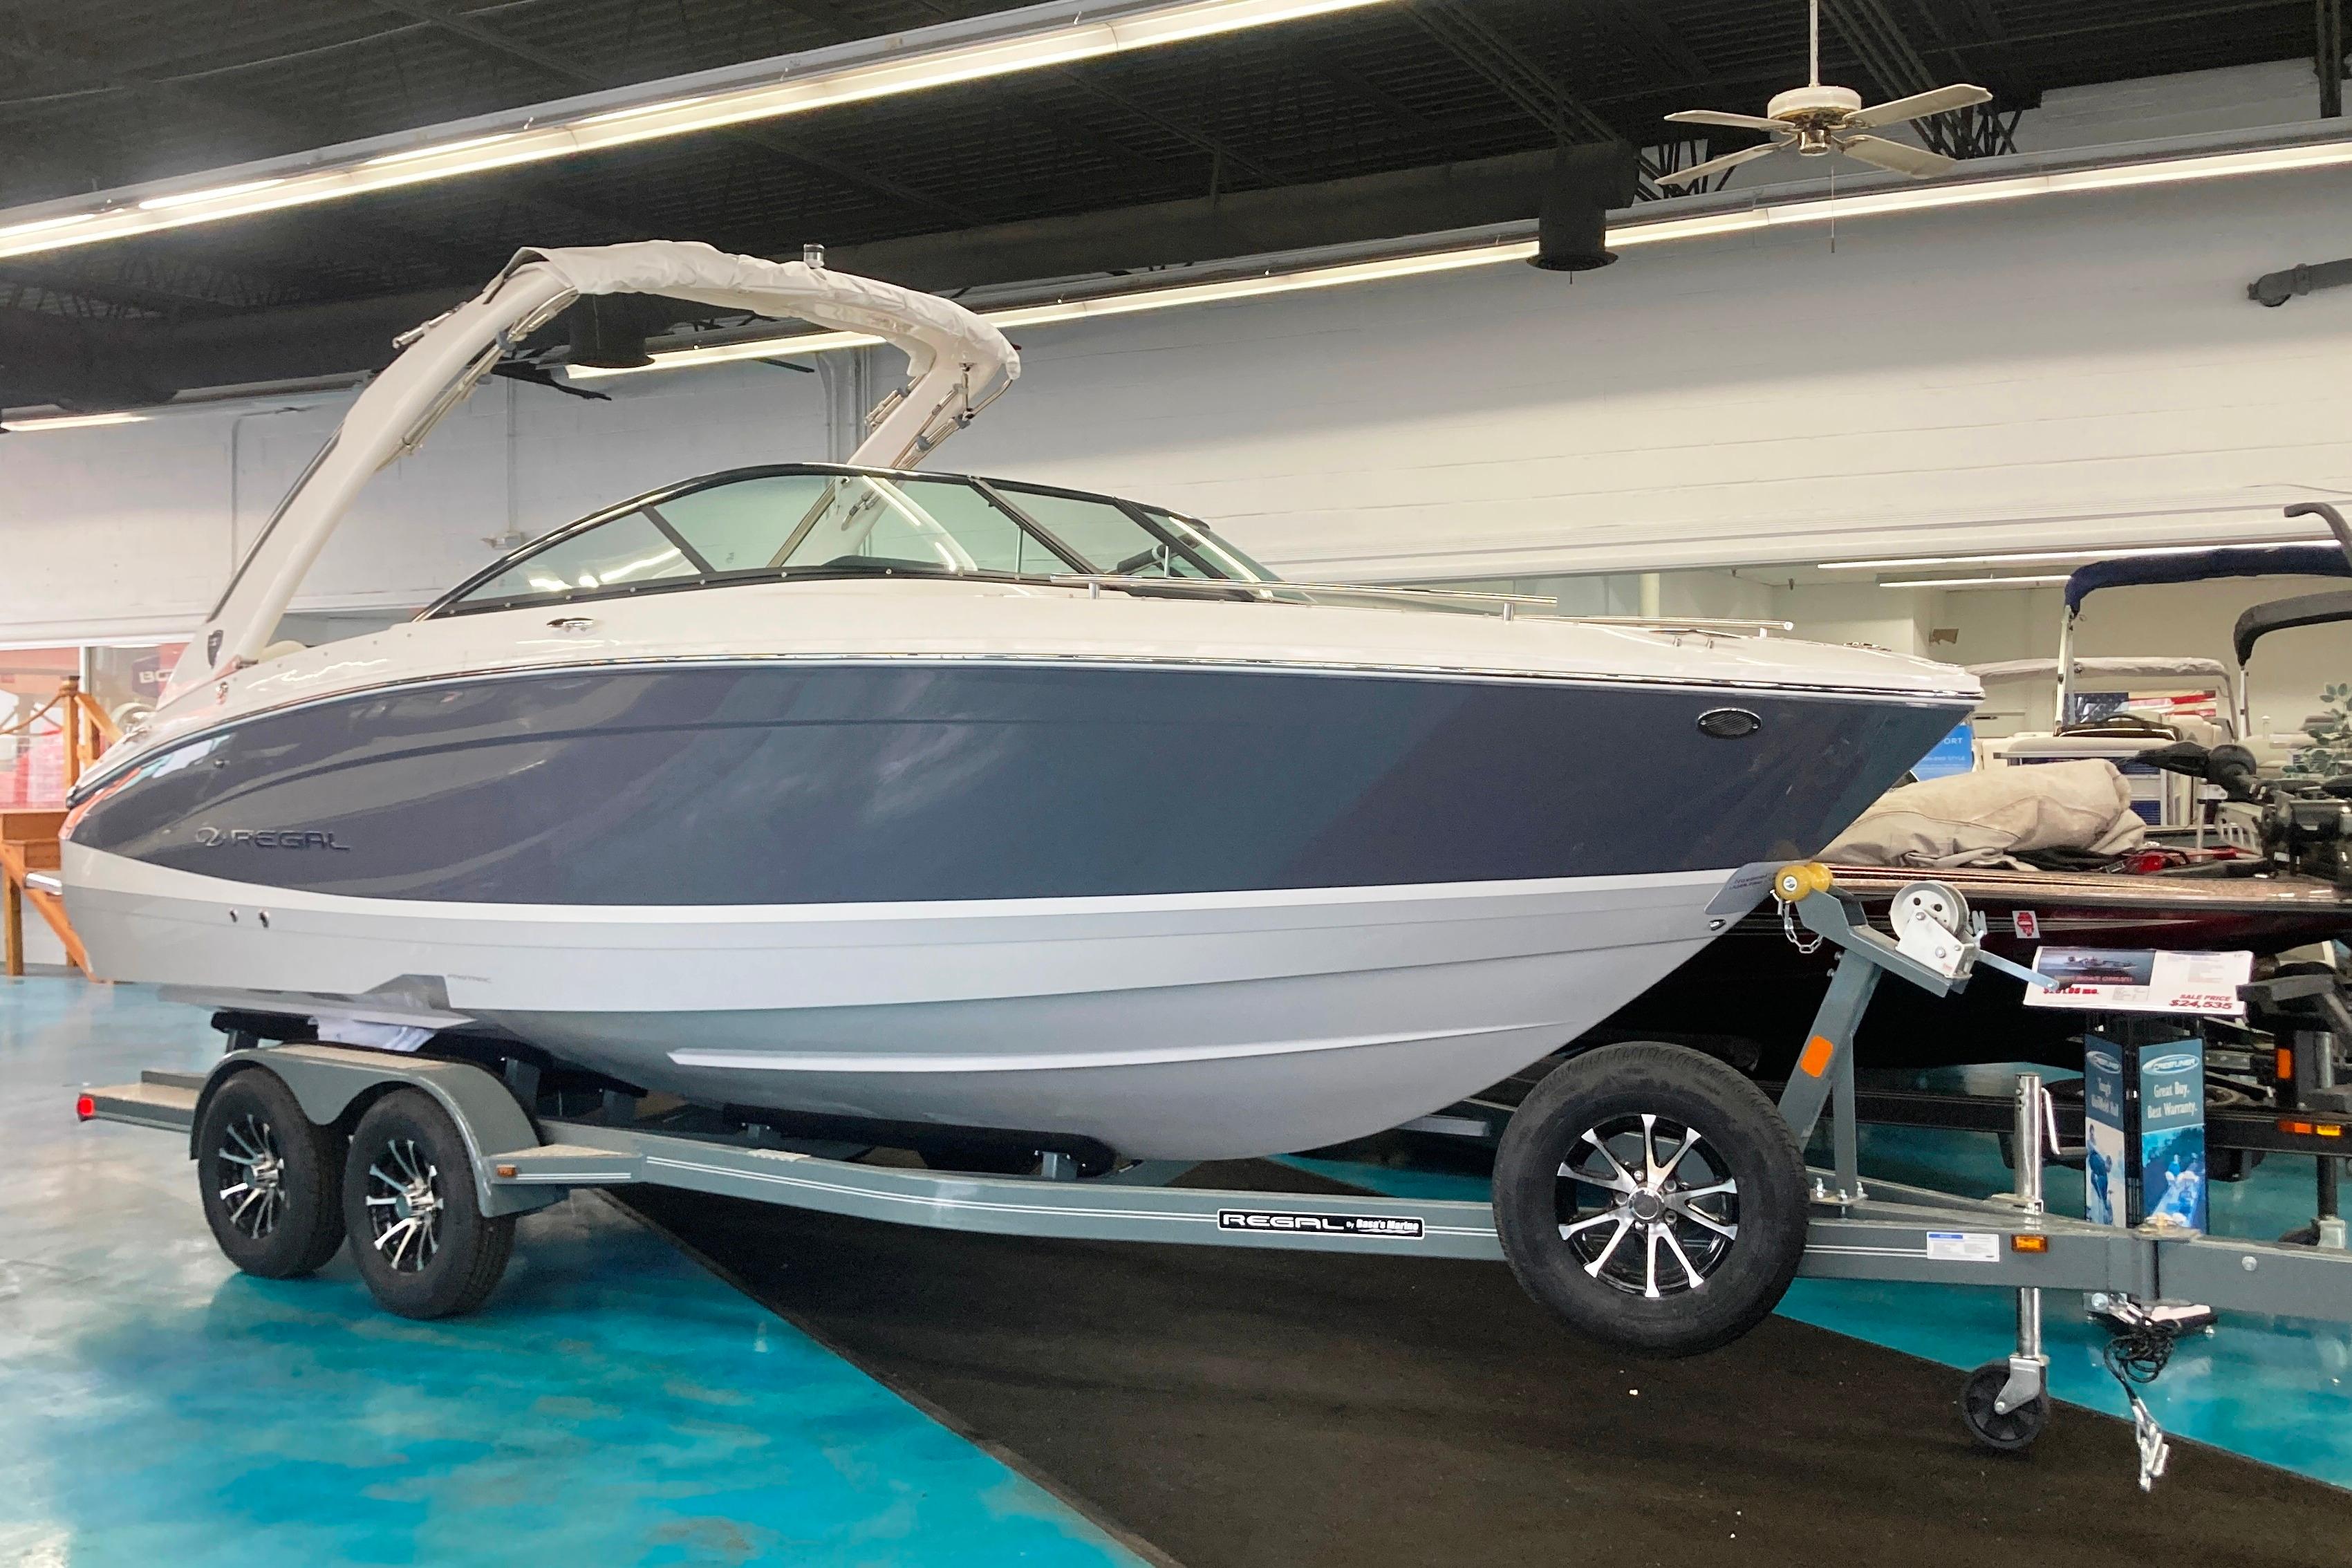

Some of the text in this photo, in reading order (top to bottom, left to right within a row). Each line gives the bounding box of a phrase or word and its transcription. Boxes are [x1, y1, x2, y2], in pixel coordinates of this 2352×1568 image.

[231, 830, 351, 850] REGAL
[2169, 1000, 2232, 1009] $24,535
[2154, 1084, 2174, 1098] Great
[2147, 1105, 2162, 1119] Best
[1223, 1213, 1344, 1230] REGAL
[1387, 1220, 1419, 1231] Marine
